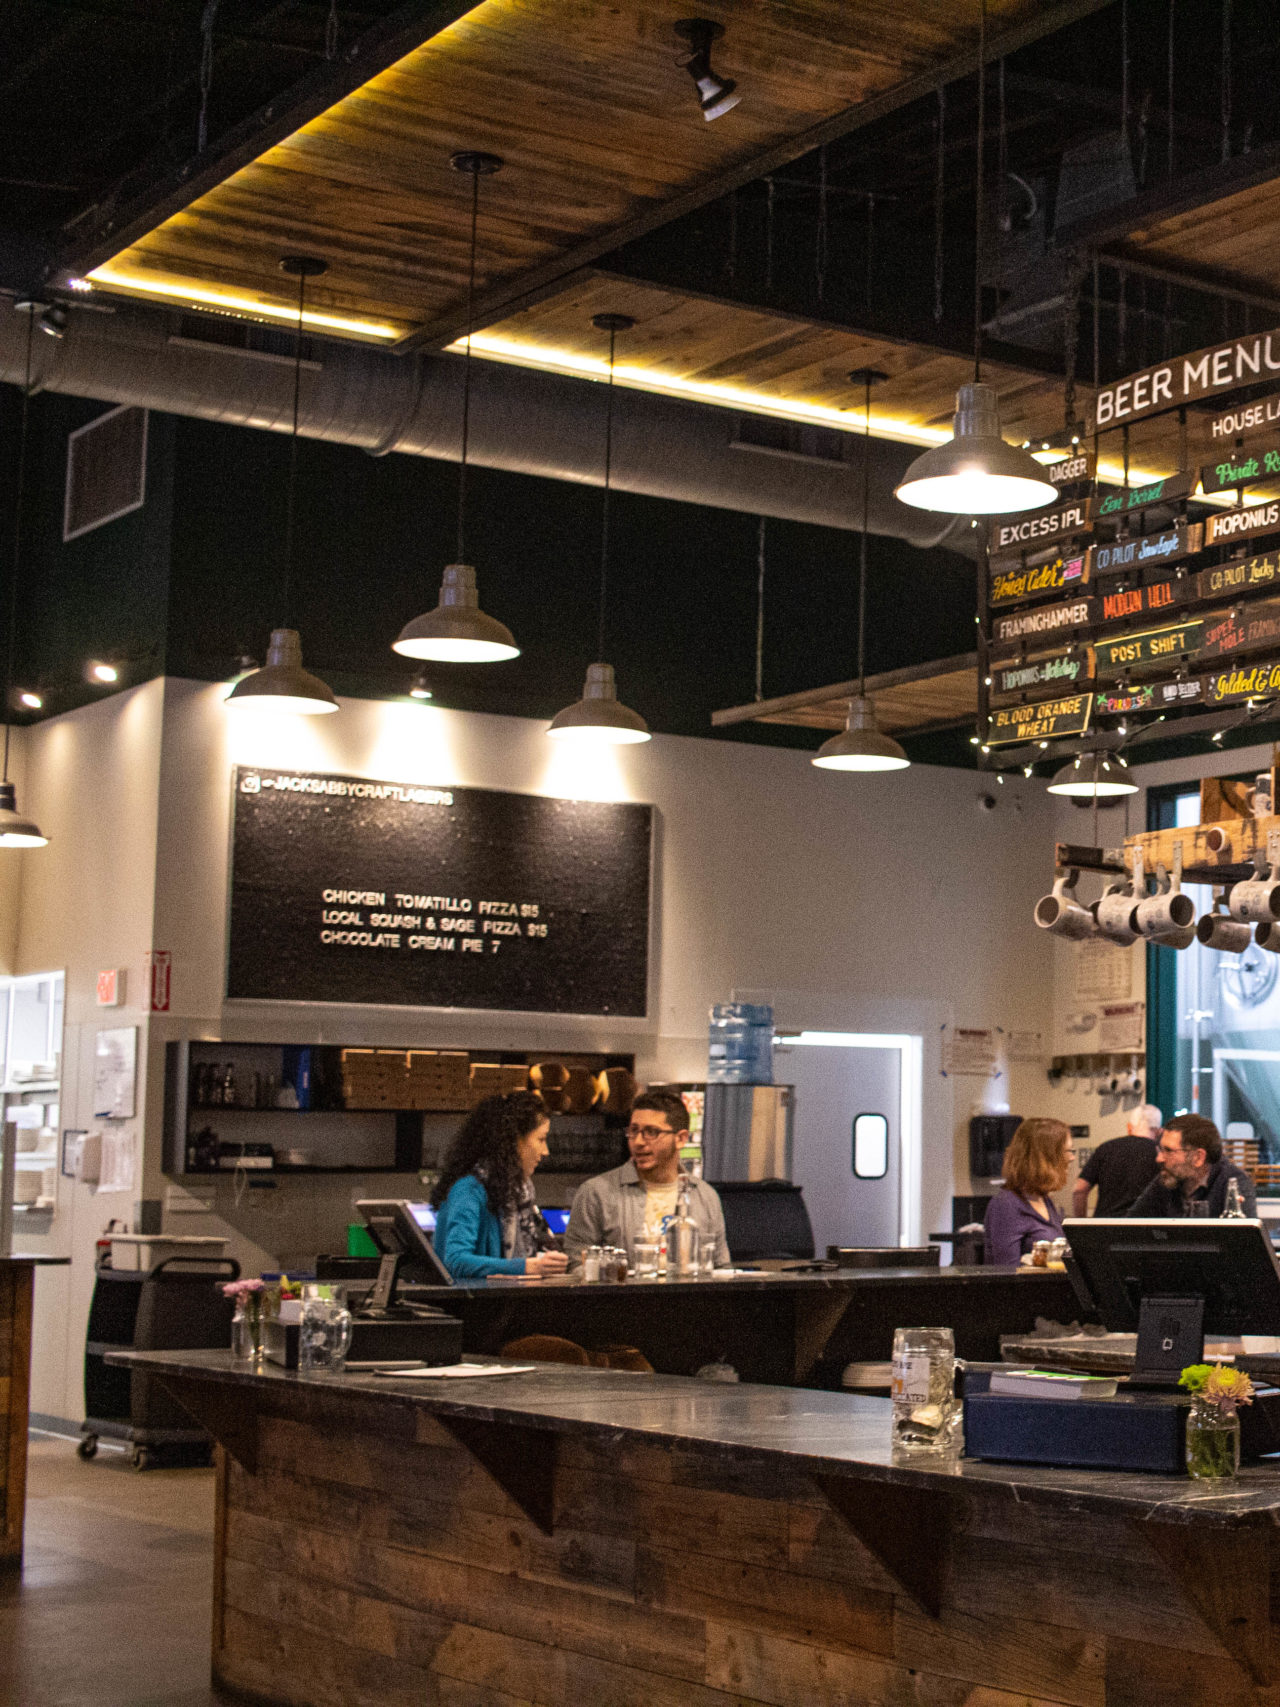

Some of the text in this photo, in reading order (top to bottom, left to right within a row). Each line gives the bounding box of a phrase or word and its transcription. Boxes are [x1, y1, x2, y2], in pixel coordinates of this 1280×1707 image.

[1096, 367, 1173, 425] BEER
[1212, 405, 1264, 438] HOUSE
[1050, 458, 1088, 483] DAGGER
[1000, 508, 1085, 546] EXCESS IPL
[1213, 504, 1280, 537] HOPONIUS
[993, 574, 1027, 600] Honey
[1147, 583, 1175, 609] HELL
[1000, 603, 1089, 639] FRAMINGHAMMER
[1110, 632, 1185, 663] POST SHIFT
[1215, 667, 1258, 701] Gilded
[1255, 670, 1268, 692] &
[997, 698, 1083, 727] BLOOD ORANGE
[1017, 717, 1057, 738] WHEAT
[322, 889, 386, 907] CHICKEN
[395, 893, 473, 913] TOMATILLO
[478, 901, 518, 918] PIZZA
[322, 909, 364, 926] LOCAL
[370, 913, 422, 930] SQUASH
[425, 916, 437, 931] &
[440, 917, 476, 933] SAGE
[483, 920, 522, 937] PIZZA
[320, 930, 401, 949] CHOCOLATE
[408, 935, 456, 952] CREAM
[462, 938, 484, 953] PIE
